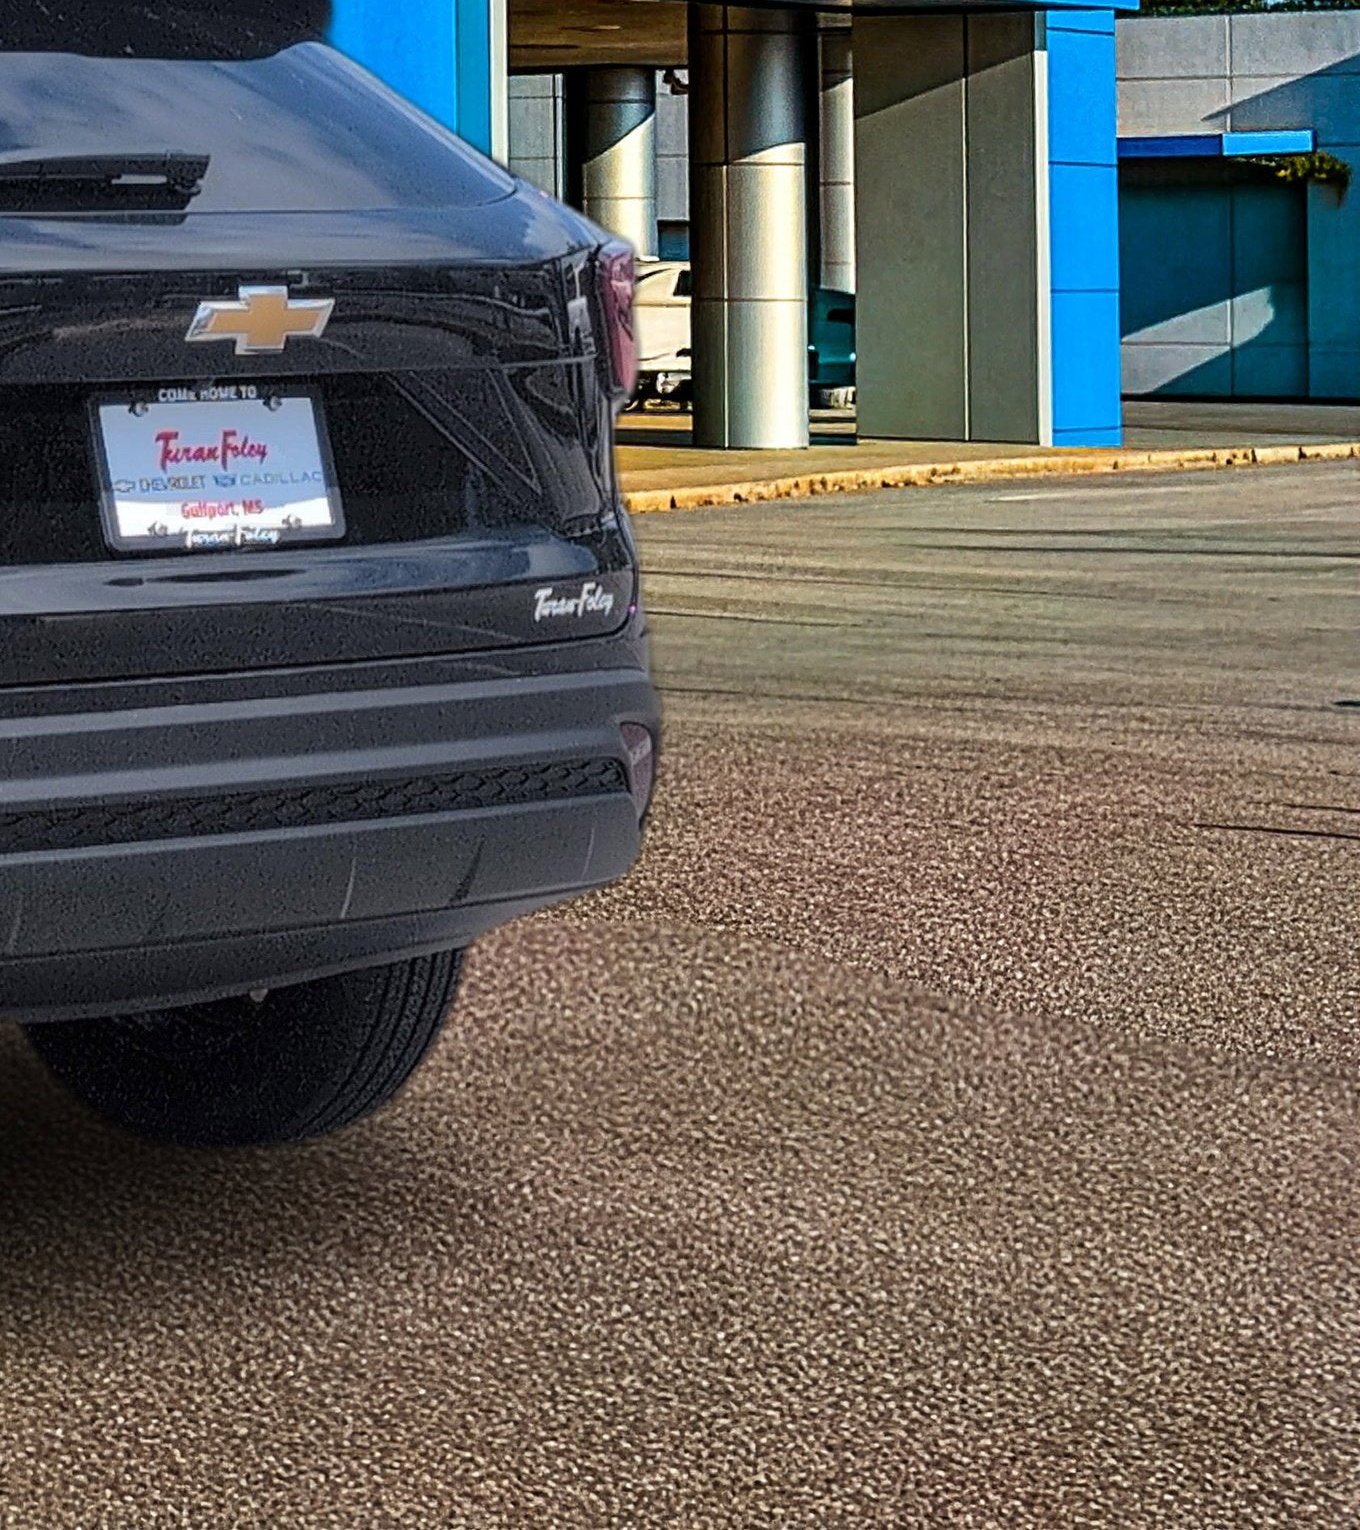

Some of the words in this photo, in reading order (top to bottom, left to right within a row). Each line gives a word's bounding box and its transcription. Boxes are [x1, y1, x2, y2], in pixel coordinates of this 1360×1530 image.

[239, 384, 257, 399] TO
[155, 430, 218, 471] Turan
[219, 429, 268, 471] Foley
[240, 470, 322, 488] CADILLAC
[242, 499, 265, 515] MS
